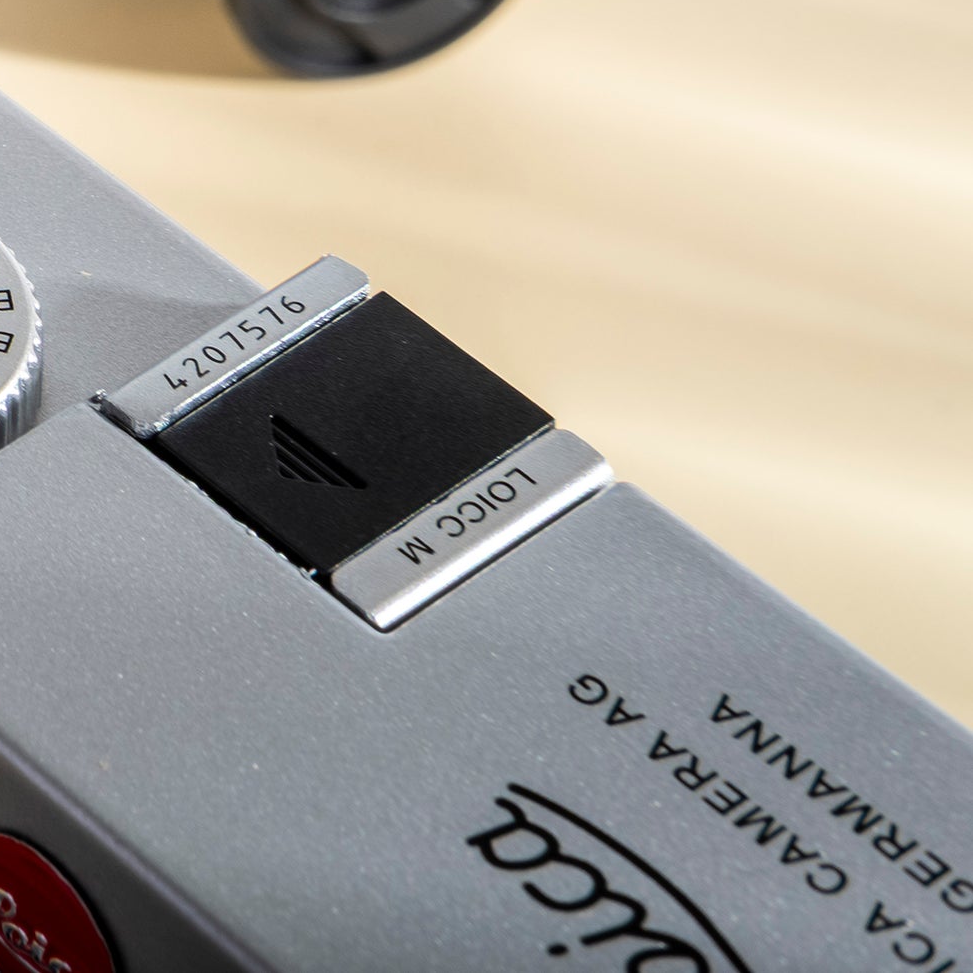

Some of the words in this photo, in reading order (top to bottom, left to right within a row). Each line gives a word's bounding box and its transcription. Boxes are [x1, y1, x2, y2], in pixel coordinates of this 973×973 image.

[162, 294, 307, 392] 4207576
[436, 466, 538, 539] LOICC
[396, 535, 437, 566] M
[567, 673, 647, 727] AG
[646, 729, 851, 896] CAMERA
[710, 692, 973, 914] GERMANNA
